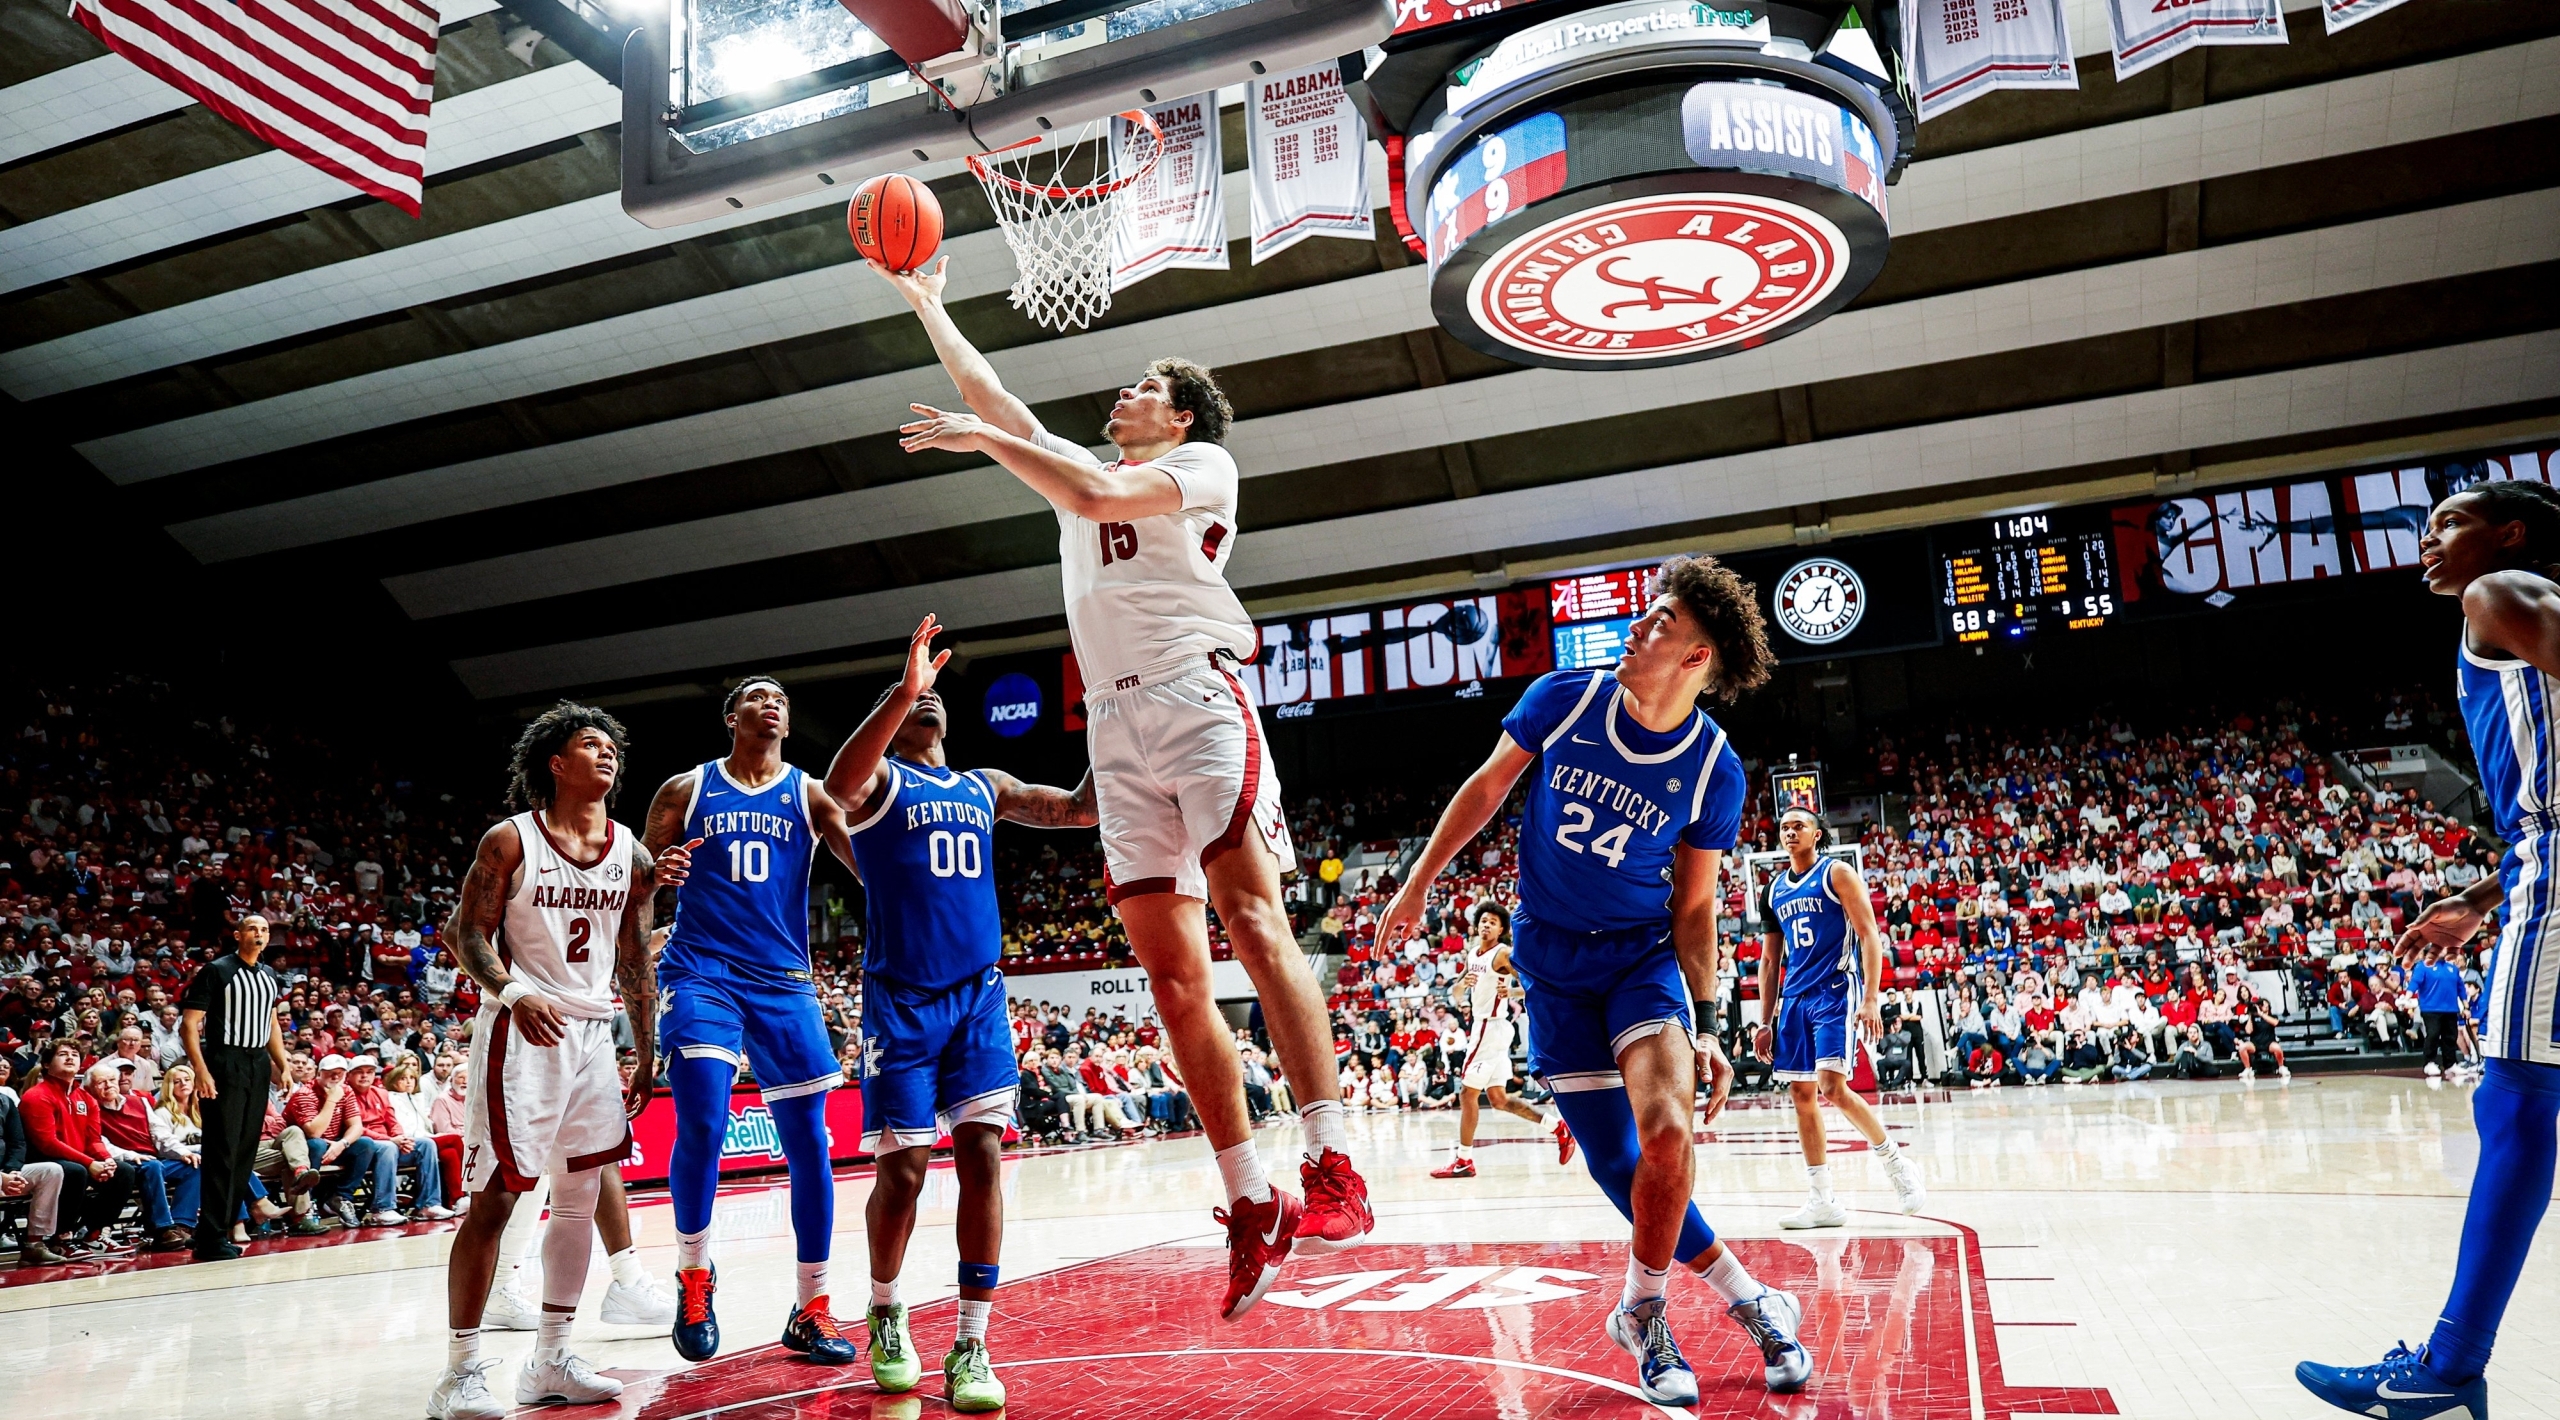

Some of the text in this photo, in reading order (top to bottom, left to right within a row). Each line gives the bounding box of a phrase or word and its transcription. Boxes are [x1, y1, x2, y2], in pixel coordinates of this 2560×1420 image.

[1566, 8, 1690, 47] Properties
[1690, 4, 1754, 27] Trust
[1943, 7, 2028, 23] 2004 2024
[1945, 19, 1978, 34] 2023
[1946, 30, 1979, 45] 2025
[1265, 96, 1345, 121] SEC TOURNAMENT
[1275, 107, 1335, 128] CHAMPIONS
[1176, 131, 1205, 143] SEASON
[1274, 124, 1337, 145] 1930 1934
[1710, 98, 1834, 167] ASSISTS
[1136, 142, 1193, 161] CHAPIONS
[1274, 134, 1338, 154] 1982 1987
[1275, 142, 1338, 163] 1989 1990
[1276, 151, 1339, 172] 1991 2021
[1482, 136, 1507, 182] 9
[1174, 177, 1194, 186] 2021
[1275, 169, 1300, 181] 2023
[1138, 202, 1195, 220] CHAMPIONS
[1484, 177, 1510, 223] 9
[1506, 224, 1634, 349] CRIMSON TIDE
[1677, 214, 1807, 340] ALABAMA
[1994, 515, 2048, 539] 11:04
[1099, 521, 1138, 567] 15
[2025, 548, 2037, 560] 00
[1784, 566, 1854, 600] ALABAMA
[1987, 609, 1996, 624] 2
[2015, 603, 2023, 617] 2
[2062, 600, 2070, 615] 3
[2084, 594, 2113, 617] 55
[1785, 601, 1856, 635] CRIMSON TIDE
[1952, 610, 1980, 632] 68
[2069, 617, 2104, 629] KENTUCKY
[1115, 675, 1141, 691] RTR
[990, 702, 1037, 722] NCAA
[1782, 776, 1816, 791] 11:04
[1550, 764, 1670, 837] KENTUCKY
[704, 811, 793, 842] KENTUCKY
[906, 801, 990, 835] KENTUCKY
[1556, 802, 1634, 868] 24
[728, 840, 769, 882] 10
[929, 830, 981, 878] 00
[532, 886, 625, 910] ALABAMA
[1777, 897, 1823, 923] KENTUCKY
[566, 917, 591, 963] 2
[1792, 917, 1814, 949] 15
[1091, 978, 1148, 995] ROLL T
